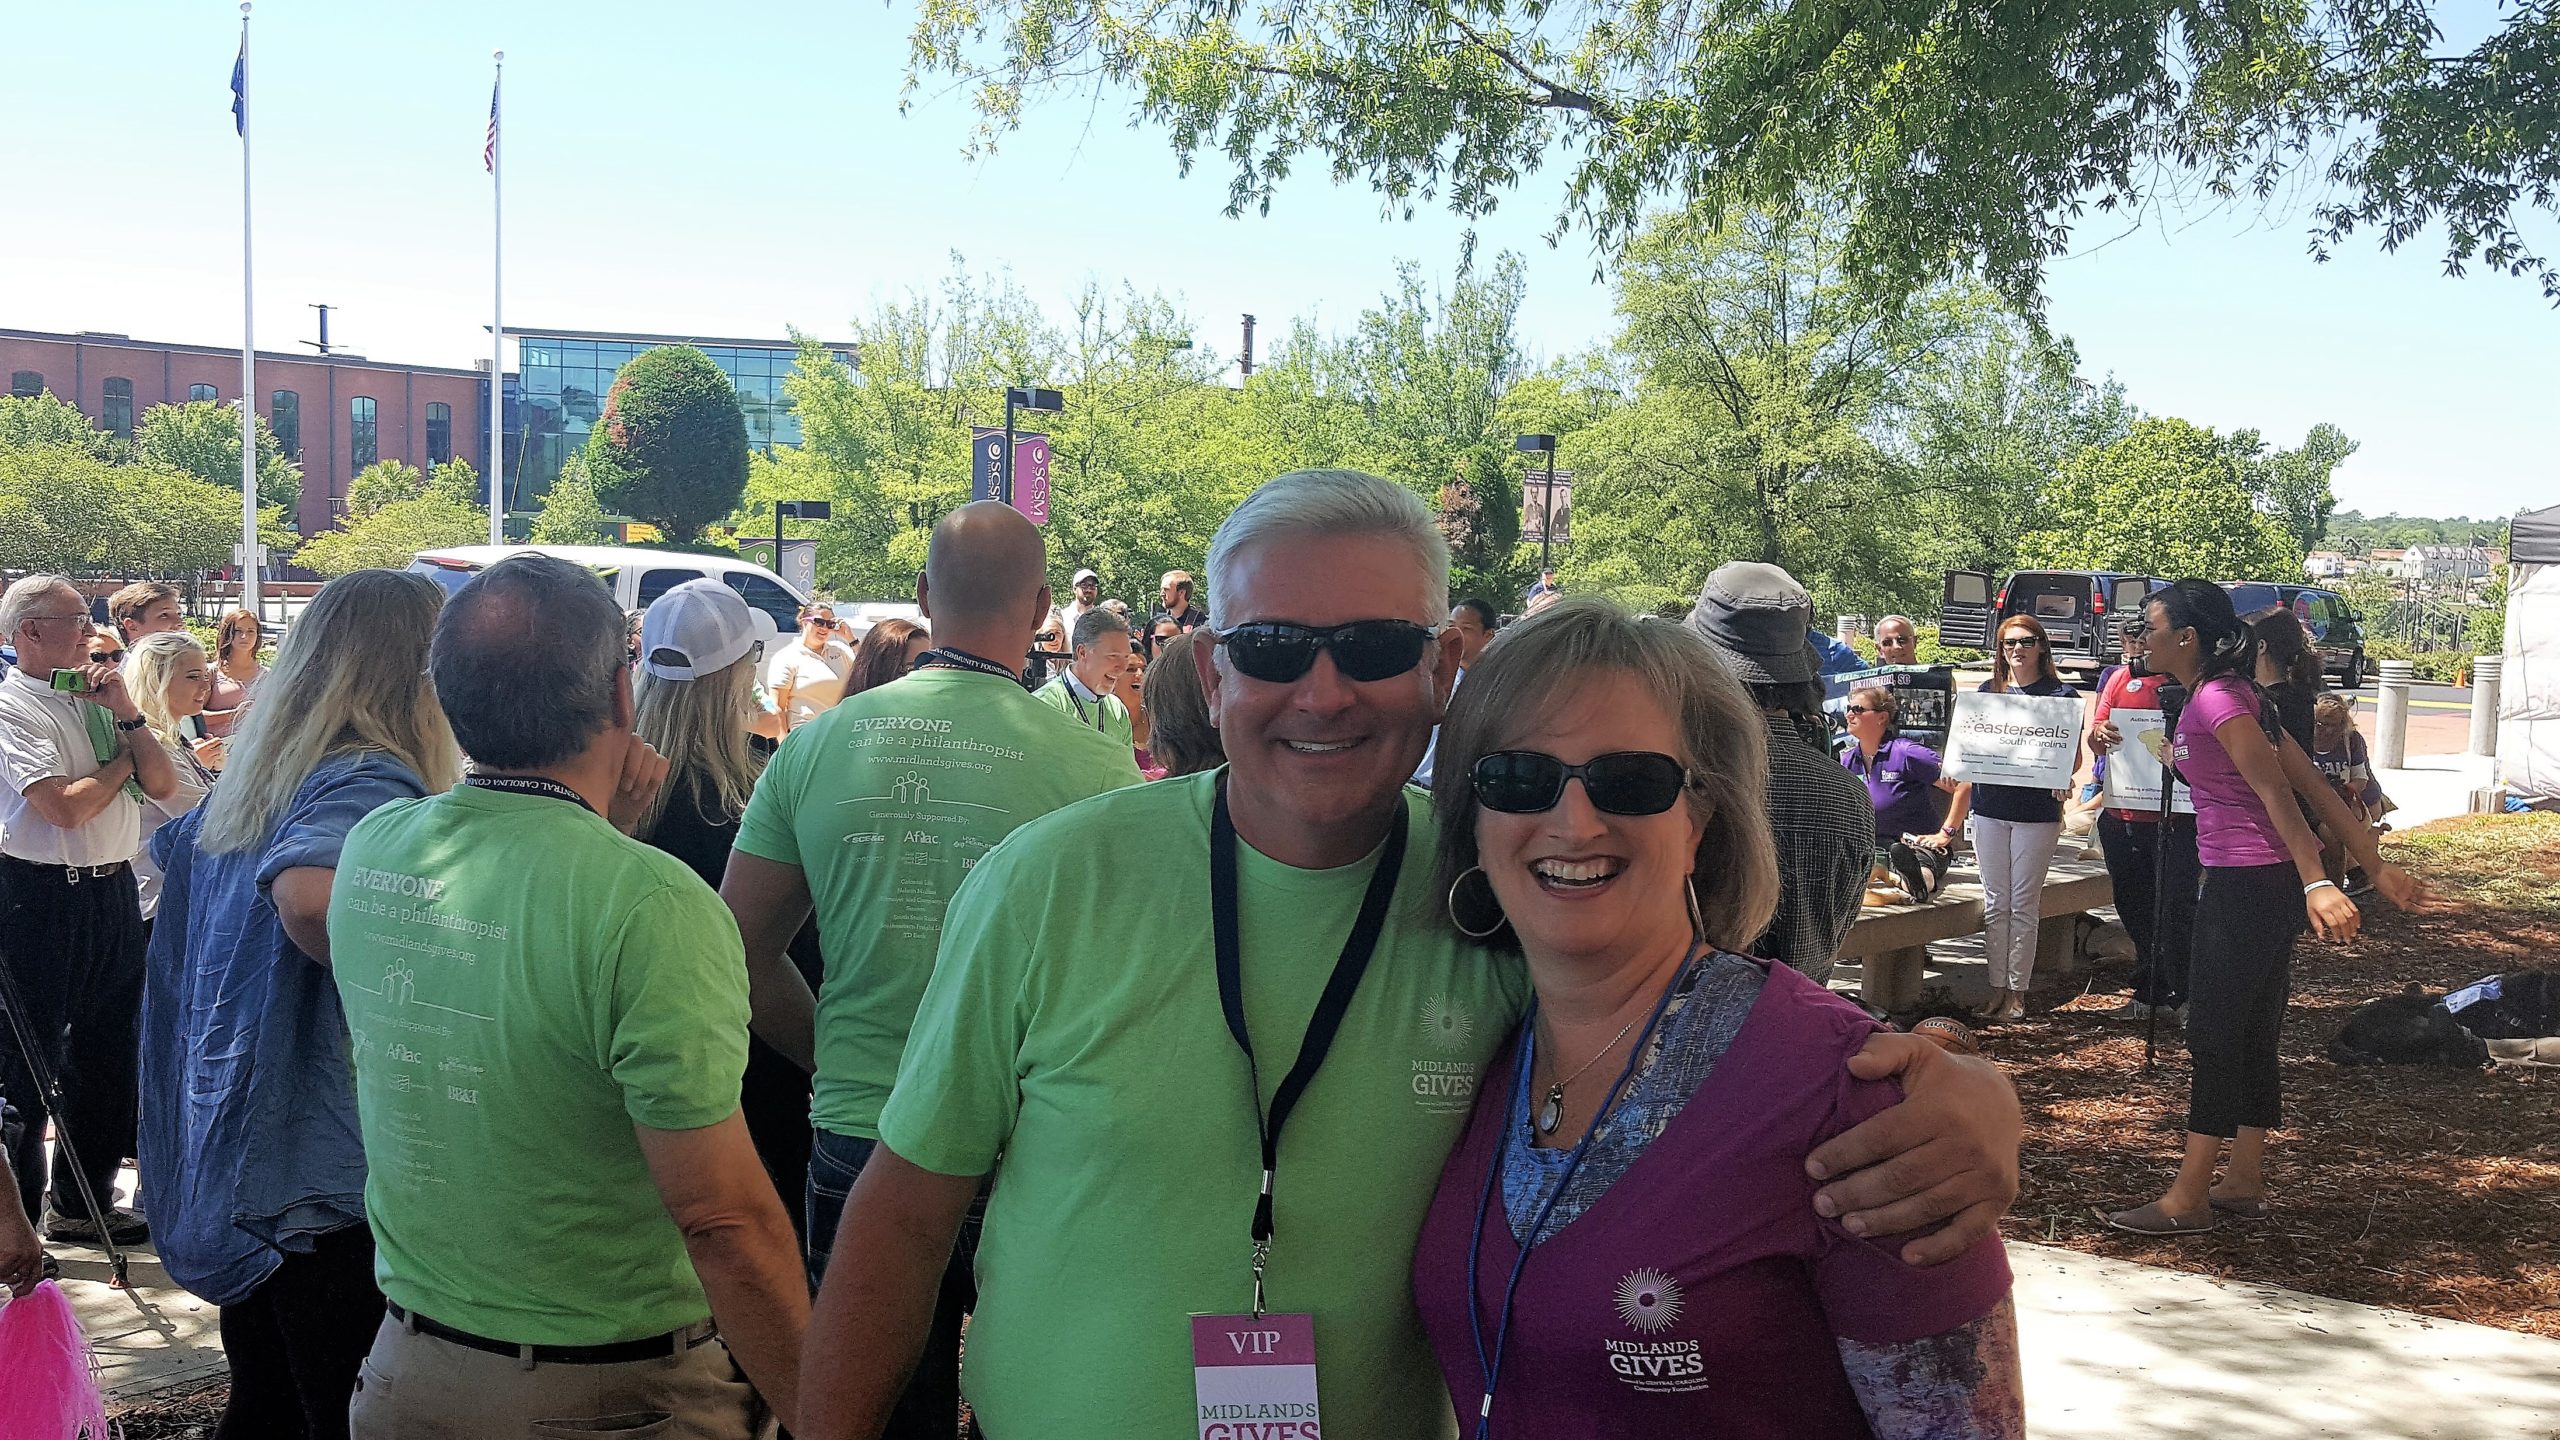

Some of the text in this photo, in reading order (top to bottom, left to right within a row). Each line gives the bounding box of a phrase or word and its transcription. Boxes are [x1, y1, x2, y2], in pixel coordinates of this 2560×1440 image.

[1034, 467, 1046, 516] SCSM
[1897, 674, 1911, 685] SC
[852, 716, 952, 733] EVERYONE
[1974, 722, 2070, 739] easterseals
[848, 733, 1025, 761] can be a philanthropist
[1999, 737, 2067, 749] South Carolina
[867, 754, 993, 774] www.midlandsgives.org
[493, 779, 539, 789] CAROLINA
[540, 782, 581, 800] CENTRAL
[869, 810, 915, 821] Generously
[916, 811, 958, 823] Supported
[904, 830, 939, 844] Aflac
[352, 866, 445, 901] EVERYONE
[347, 895, 510, 940] can be a philanthropist
[386, 1043, 422, 1064] Aflac
[1411, 1060, 1474, 1073] MIDLANDS
[1412, 1074, 1473, 1096] GIVES
[1225, 1331, 1281, 1354] VIP
[1604, 1339, 1699, 1354] MIDLANDS
[1609, 1353, 1703, 1376] GIVES
[1201, 1403, 1317, 1419] MIDLANDS
[1204, 1421, 1320, 1440] GIVES
